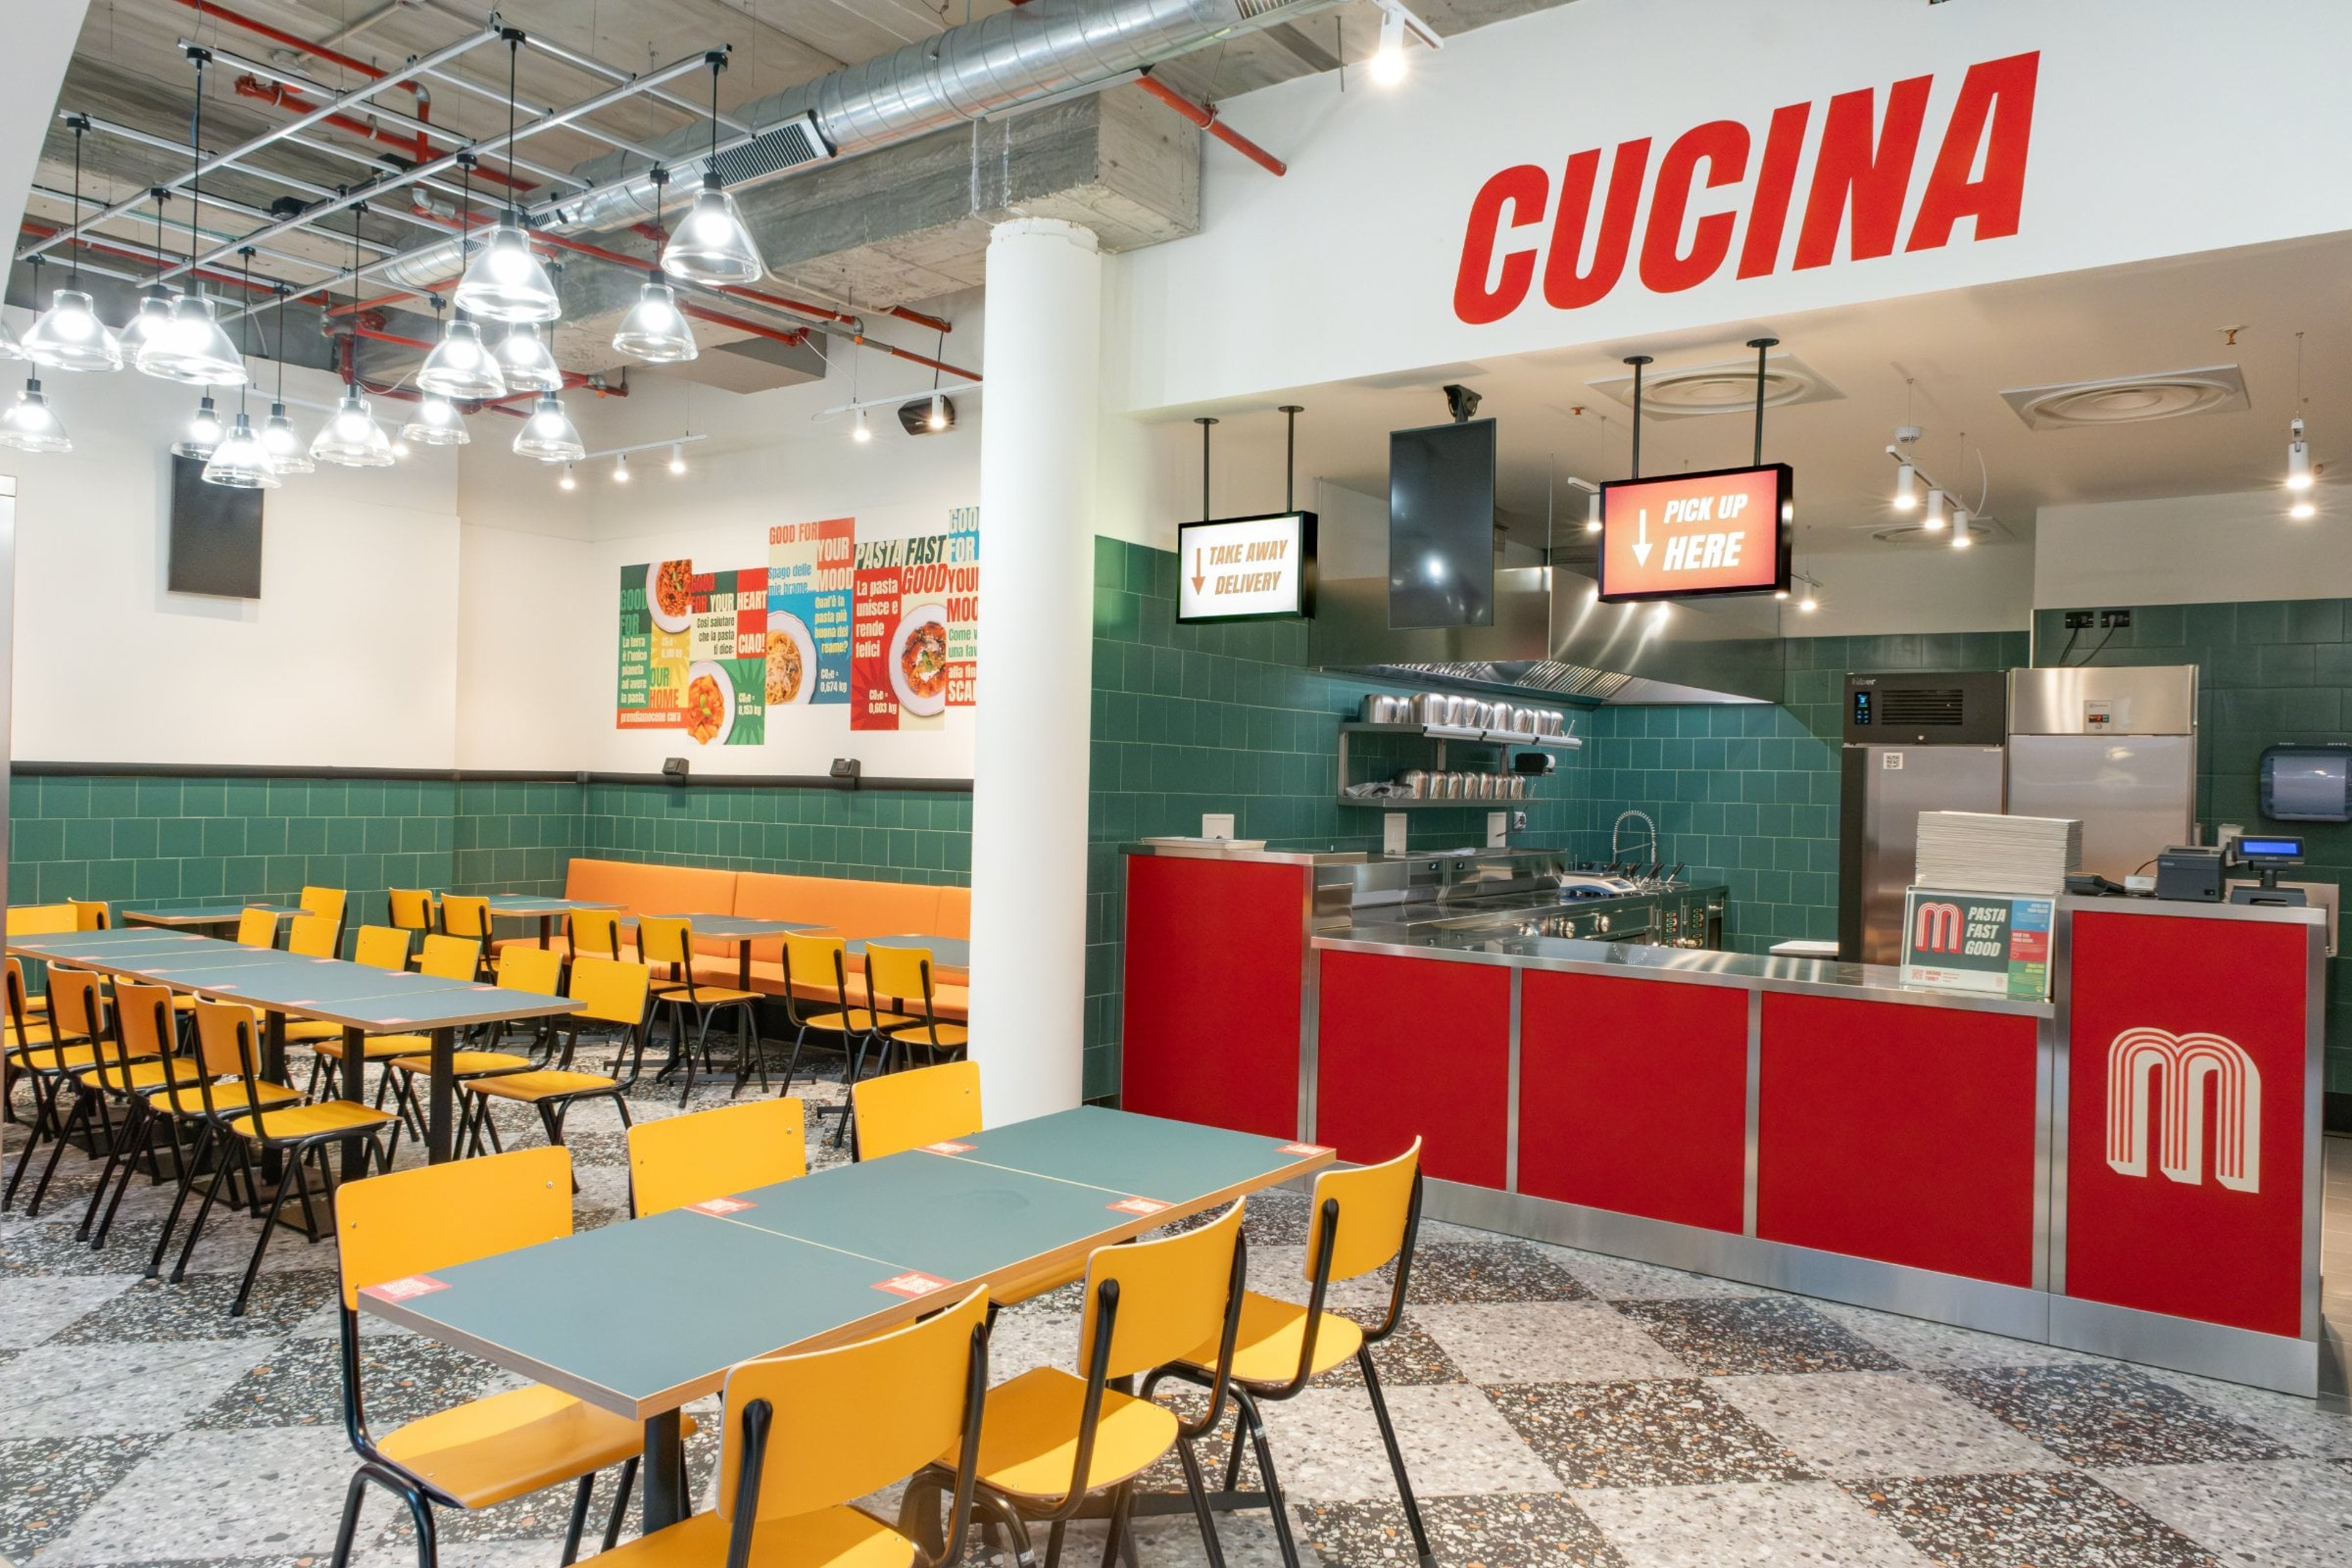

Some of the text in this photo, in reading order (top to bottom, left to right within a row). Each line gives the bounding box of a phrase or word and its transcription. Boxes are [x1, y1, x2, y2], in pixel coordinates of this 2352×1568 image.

[1453, 50, 2041, 325] CUCINA
[1664, 494, 1749, 524] PICK UP
[949, 507, 979, 533] GOO
[769, 522, 818, 545] GOOD FOR
[817, 537, 850, 562] YOUR
[853, 535, 947, 570] PASTA FAST
[949, 537, 975, 562] FOR
[1210, 540, 1288, 565] TAKE AWAY
[1662, 531, 1746, 571] HERE
[769, 564, 811, 579] Spago delle
[818, 567, 854, 592] MOOD
[901, 563, 948, 595] GOOD
[769, 582, 782, 596] mie
[857, 578, 898, 597] La pasta
[1215, 571, 1281, 595] DELIVERY
[710, 593, 734, 612] YOUR
[737, 590, 767, 610] HEART
[838, 595, 845, 607] la
[857, 599, 898, 617] unisce e
[620, 613, 639, 635] FOR
[710, 616, 734, 627] salutare
[815, 612, 834, 624] pasta
[699, 630, 734, 642] che la pasta
[856, 620, 884, 638] rende
[949, 628, 971, 641] Come
[623, 637, 645, 648] La terra
[714, 643, 718, 655] ti
[738, 633, 765, 654] CIAO!
[821, 641, 848, 654] reame?
[856, 641, 880, 658] felici
[949, 647, 963, 658] una
[948, 666, 963, 679] alla
[839, 680, 847, 693] kg
[649, 688, 679, 710] HOME
[753, 705, 761, 717] kg
[888, 703, 897, 715] kg
[1967, 907, 2007, 922] PASTA
[1966, 924, 1999, 939] FAST
[1964, 941, 2001, 957] GOOD
